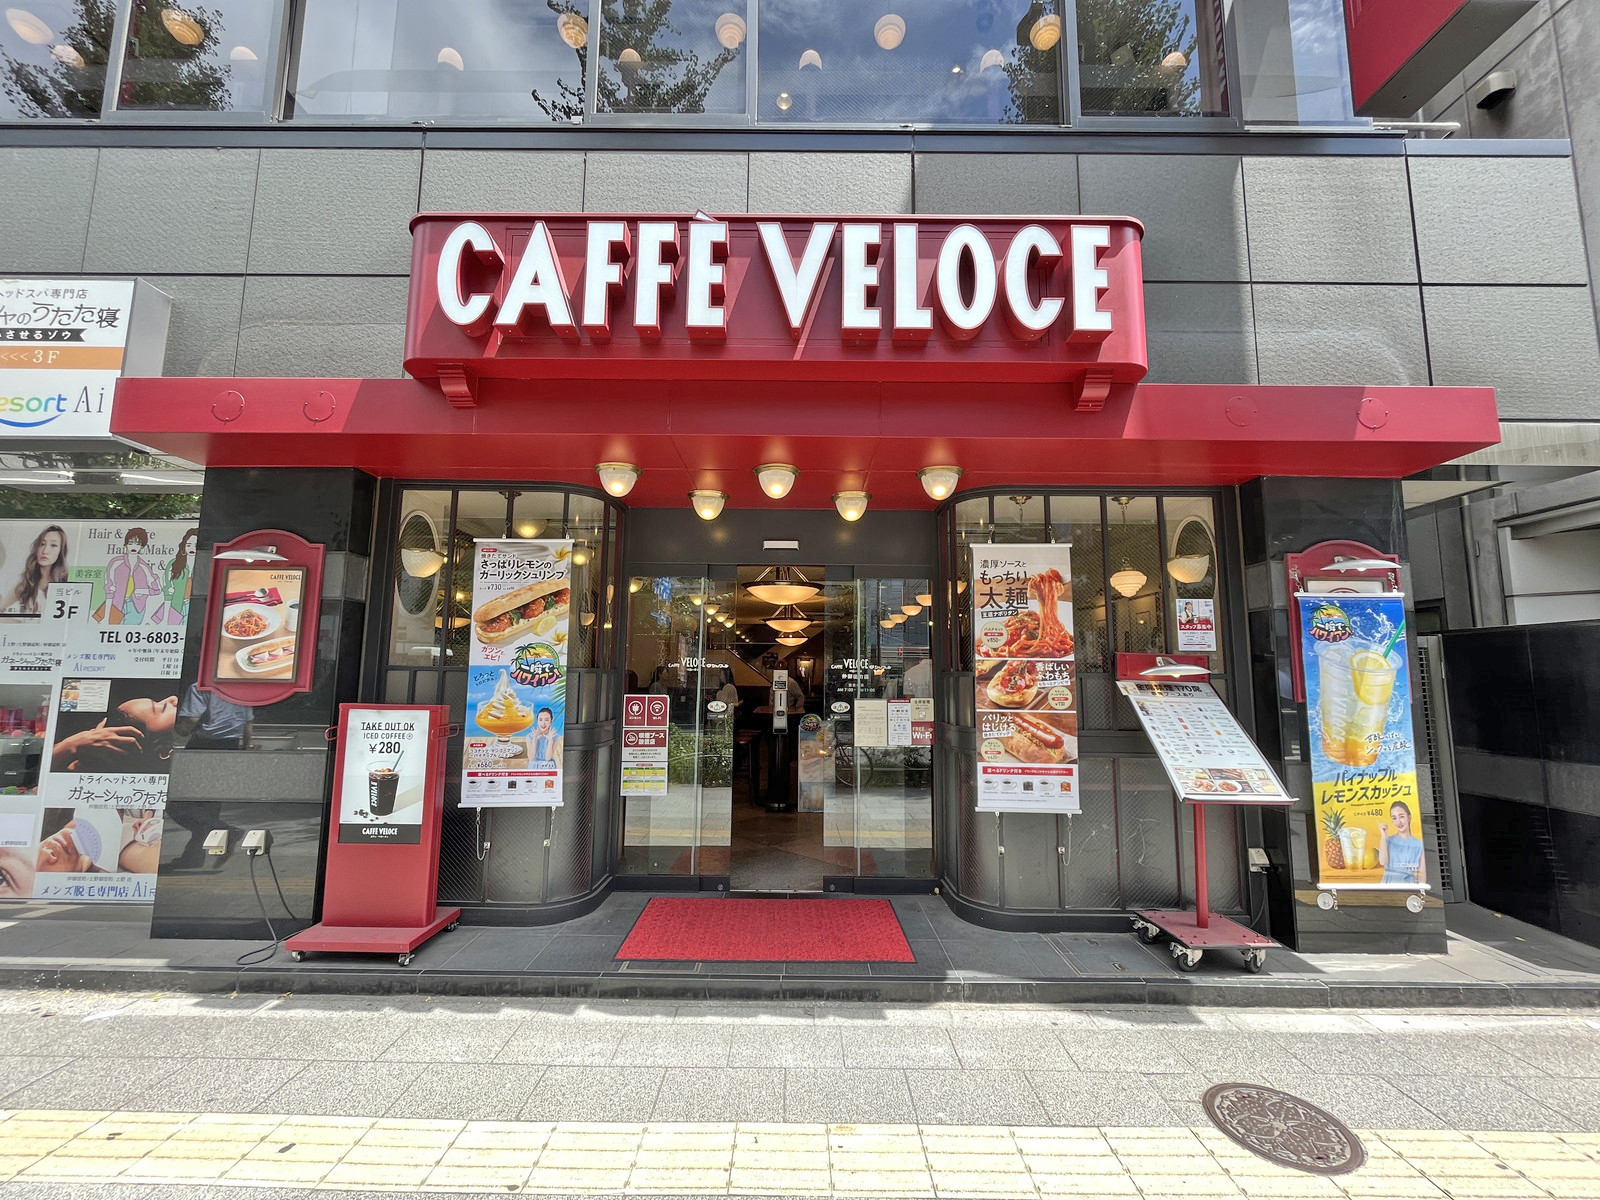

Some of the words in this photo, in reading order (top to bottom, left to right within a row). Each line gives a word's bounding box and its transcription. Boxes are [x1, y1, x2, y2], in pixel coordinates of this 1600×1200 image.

[756, 221, 1113, 333] VELOCE
[0, 301, 121, 329] ャのうたた寝
[0, 330, 72, 340] させるゾウ
[88, 528, 112, 539] Hair
[106, 543, 127, 555] Hai
[480, 559, 552, 569] さっぱりレモンの
[980, 560, 1027, 569] 濃厚ソースと
[74, 568, 102, 579] 美容室
[479, 569, 566, 581] ガーリックシュリンプ
[980, 570, 1029, 586] もっちり
[979, 586, 1029, 610] 太麺
[99, 631, 121, 644] TEL
[125, 631, 184, 645] 03-6803-
[681, 657, 706, 668] VELOE
[361, 722, 382, 731] TAKE
[384, 722, 402, 731] OUT
[403, 723, 415, 731] OK
[368, 741, 401, 755] ¥280
[79, 775, 168, 785] ドライヘッドスパ専門
[1333, 766, 1398, 787] パイナップル
[1321, 784, 1412, 806] レモンスカッシュ
[41, 885, 129, 898] メンズ脱毛専門店
